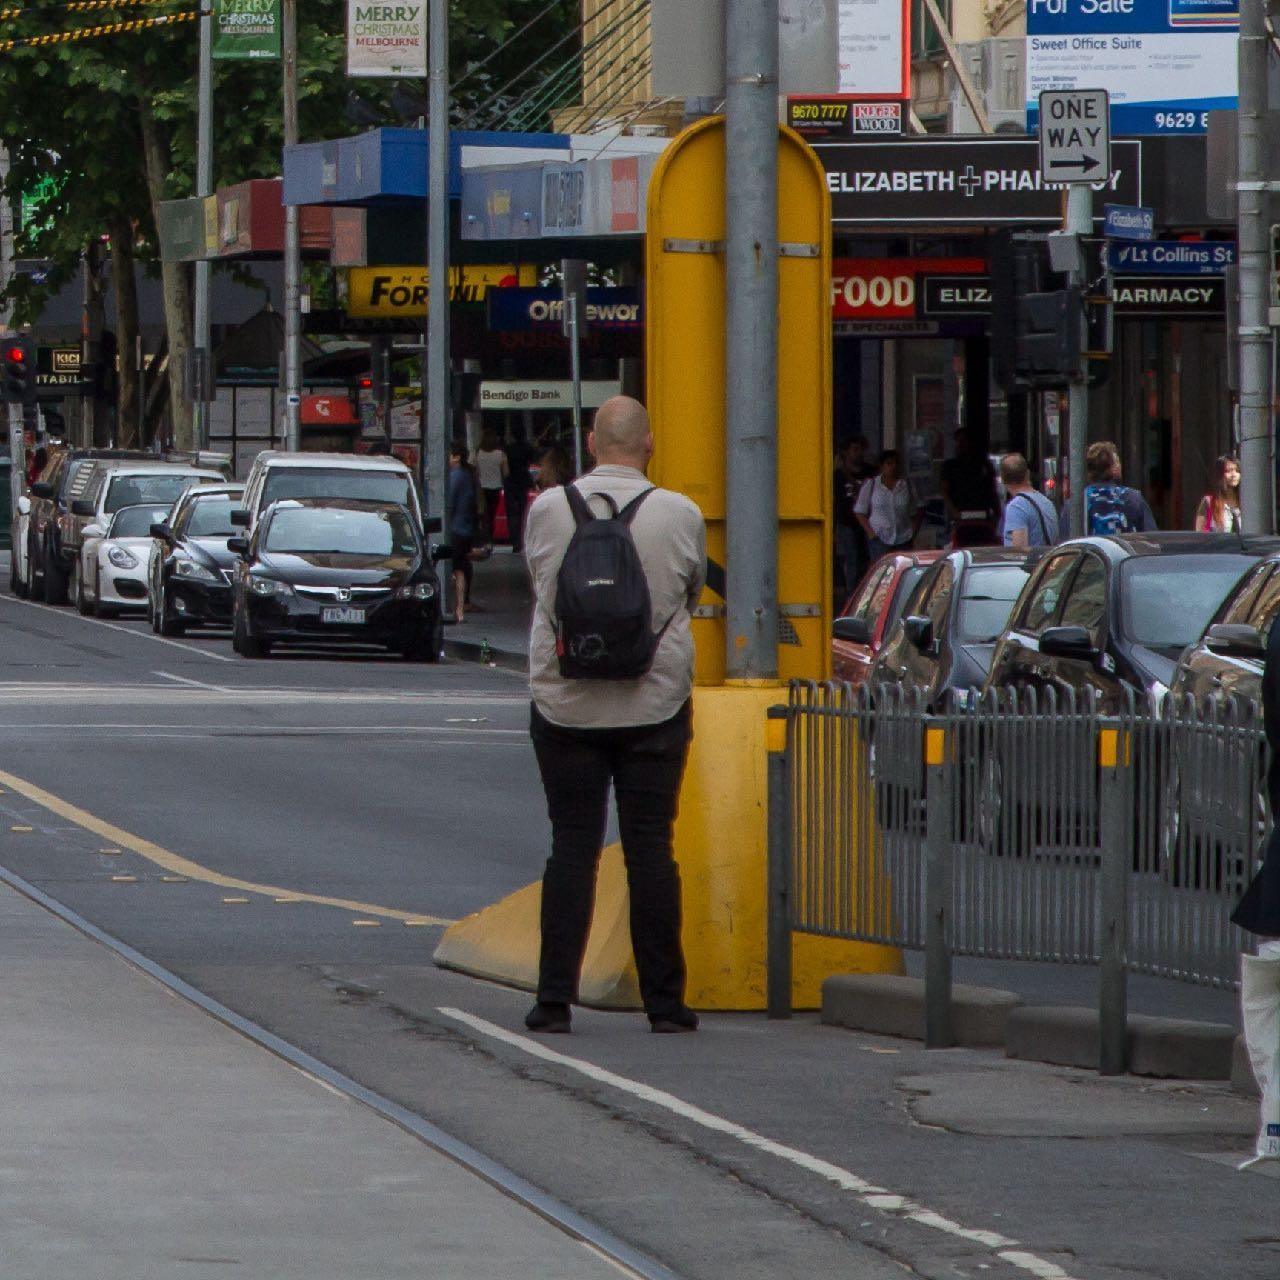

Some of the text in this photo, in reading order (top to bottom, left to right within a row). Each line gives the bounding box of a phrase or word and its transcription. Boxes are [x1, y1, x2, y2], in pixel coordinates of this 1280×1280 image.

[220, 0, 275, 12] MERRY
[356, 6, 420, 21] MERRY
[219, 13, 275, 25] CHRISTMAS
[354, 23, 420, 36] CHRISTMAS
[356, 37, 420, 47] MELBOURNE
[1031, 36, 1142, 50] Sweet Office Suite
[821, 104, 848, 119] 7777
[1050, 98, 1098, 120] ONE
[859, 119, 897, 131] WOOD
[1154, 112, 1196, 128] 9629
[1047, 126, 1102, 148] WAY
[825, 170, 955, 192] ELIZABETH
[1131, 246, 1233, 263] Lt Collins St
[831, 276, 915, 308] FOOD
[940, 288, 993, 303] ELIZ
[481, 389, 561, 402] Bendigo Bank
